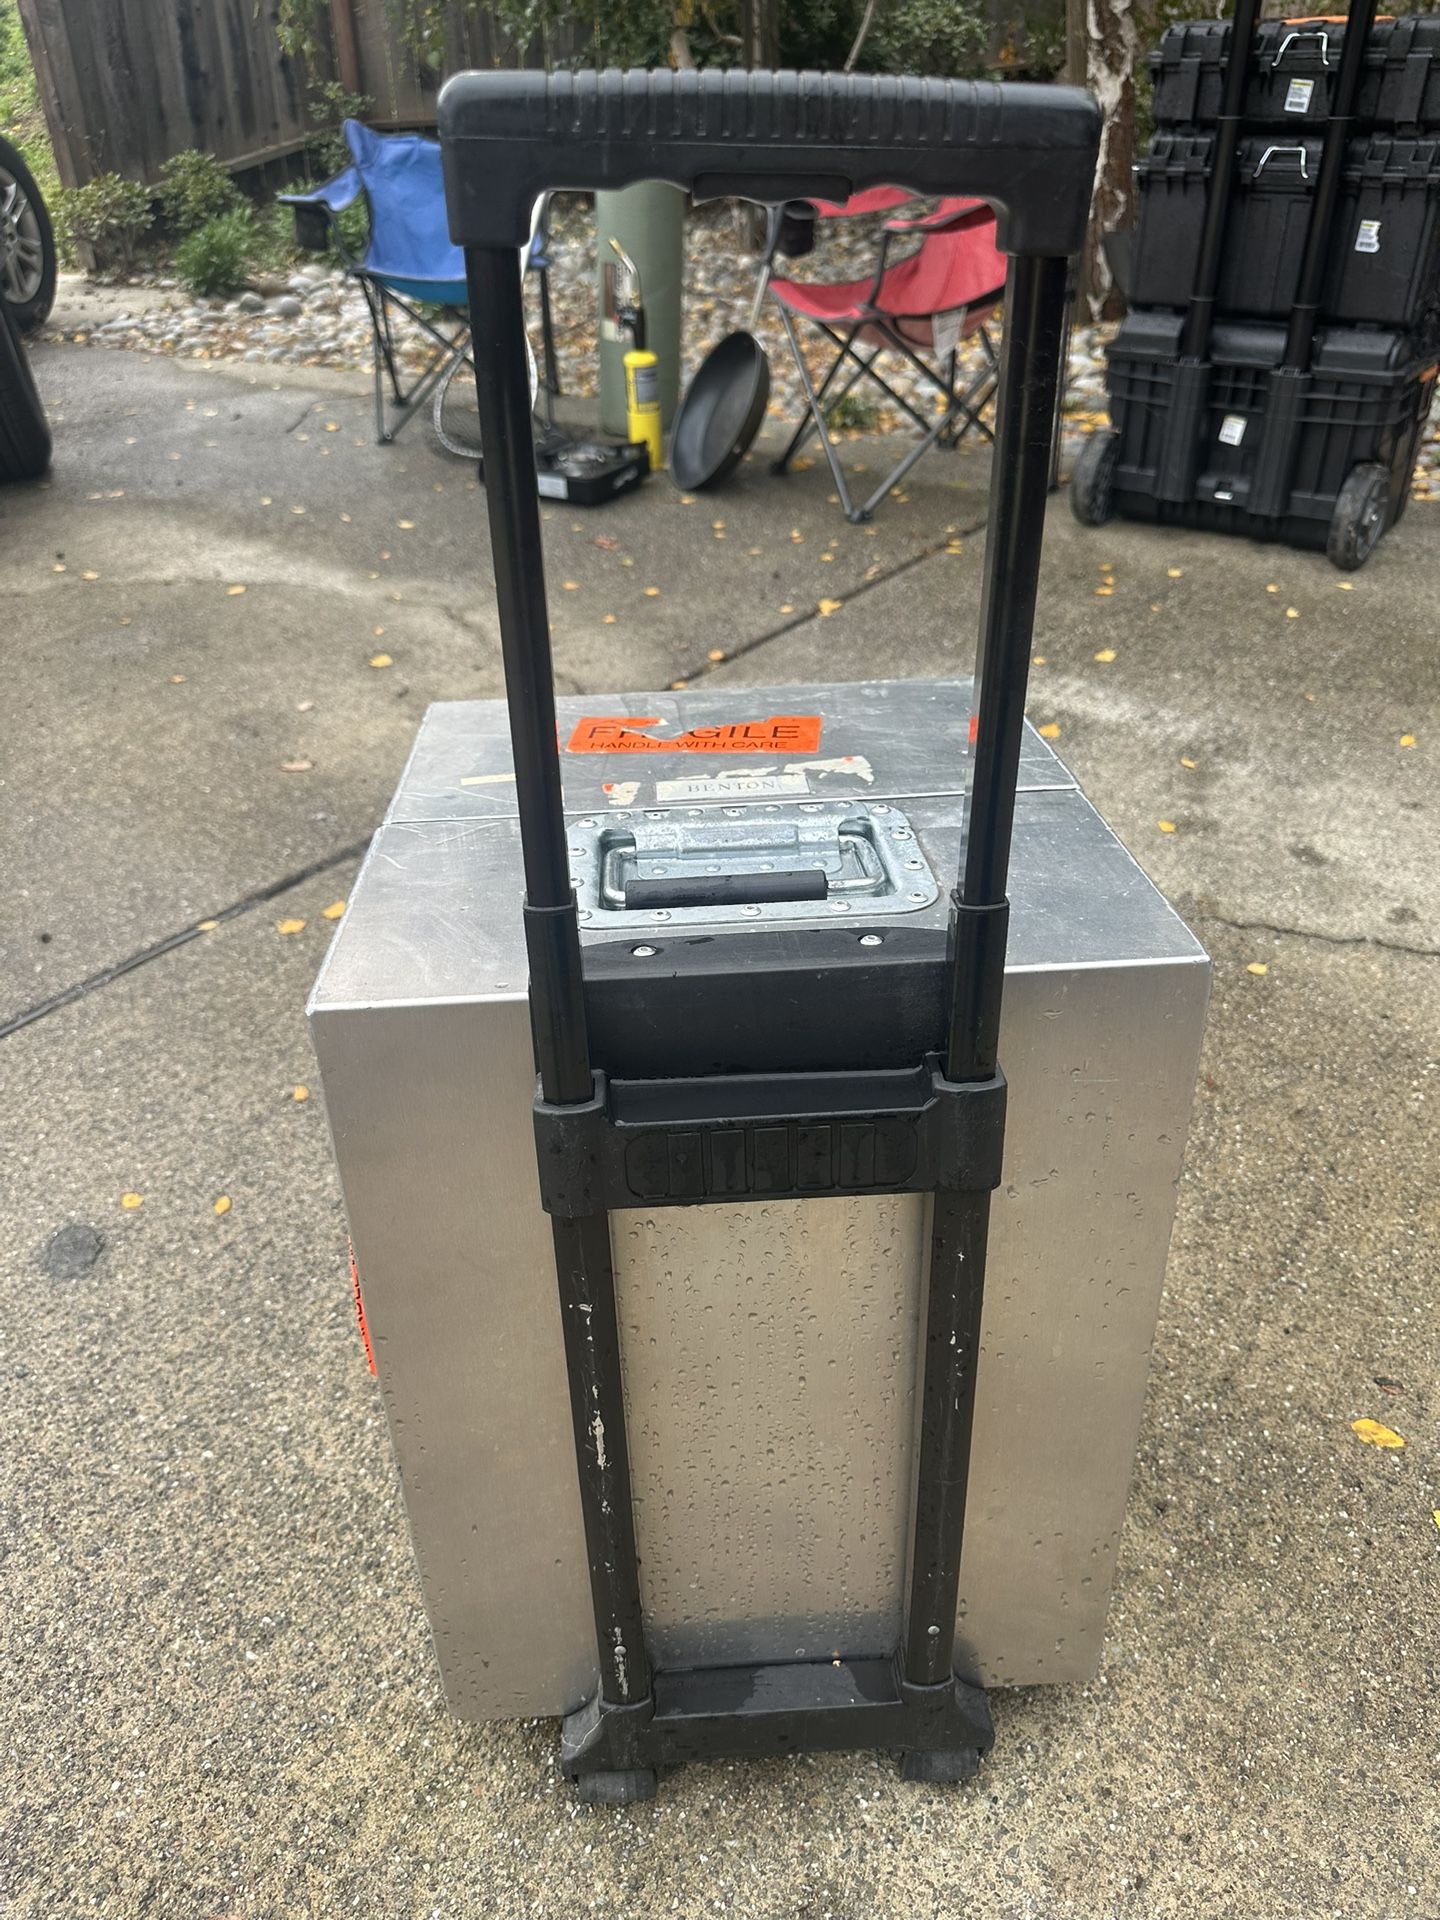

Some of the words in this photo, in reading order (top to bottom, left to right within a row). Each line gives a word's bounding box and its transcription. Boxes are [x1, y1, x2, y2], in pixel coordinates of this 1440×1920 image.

[588, 725, 800, 739] FGILE
[590, 741, 670, 749] HANDLE
[675, 741, 726, 749] WITH
[731, 741, 788, 749] CARE
[687, 780, 775, 793] BENTON
